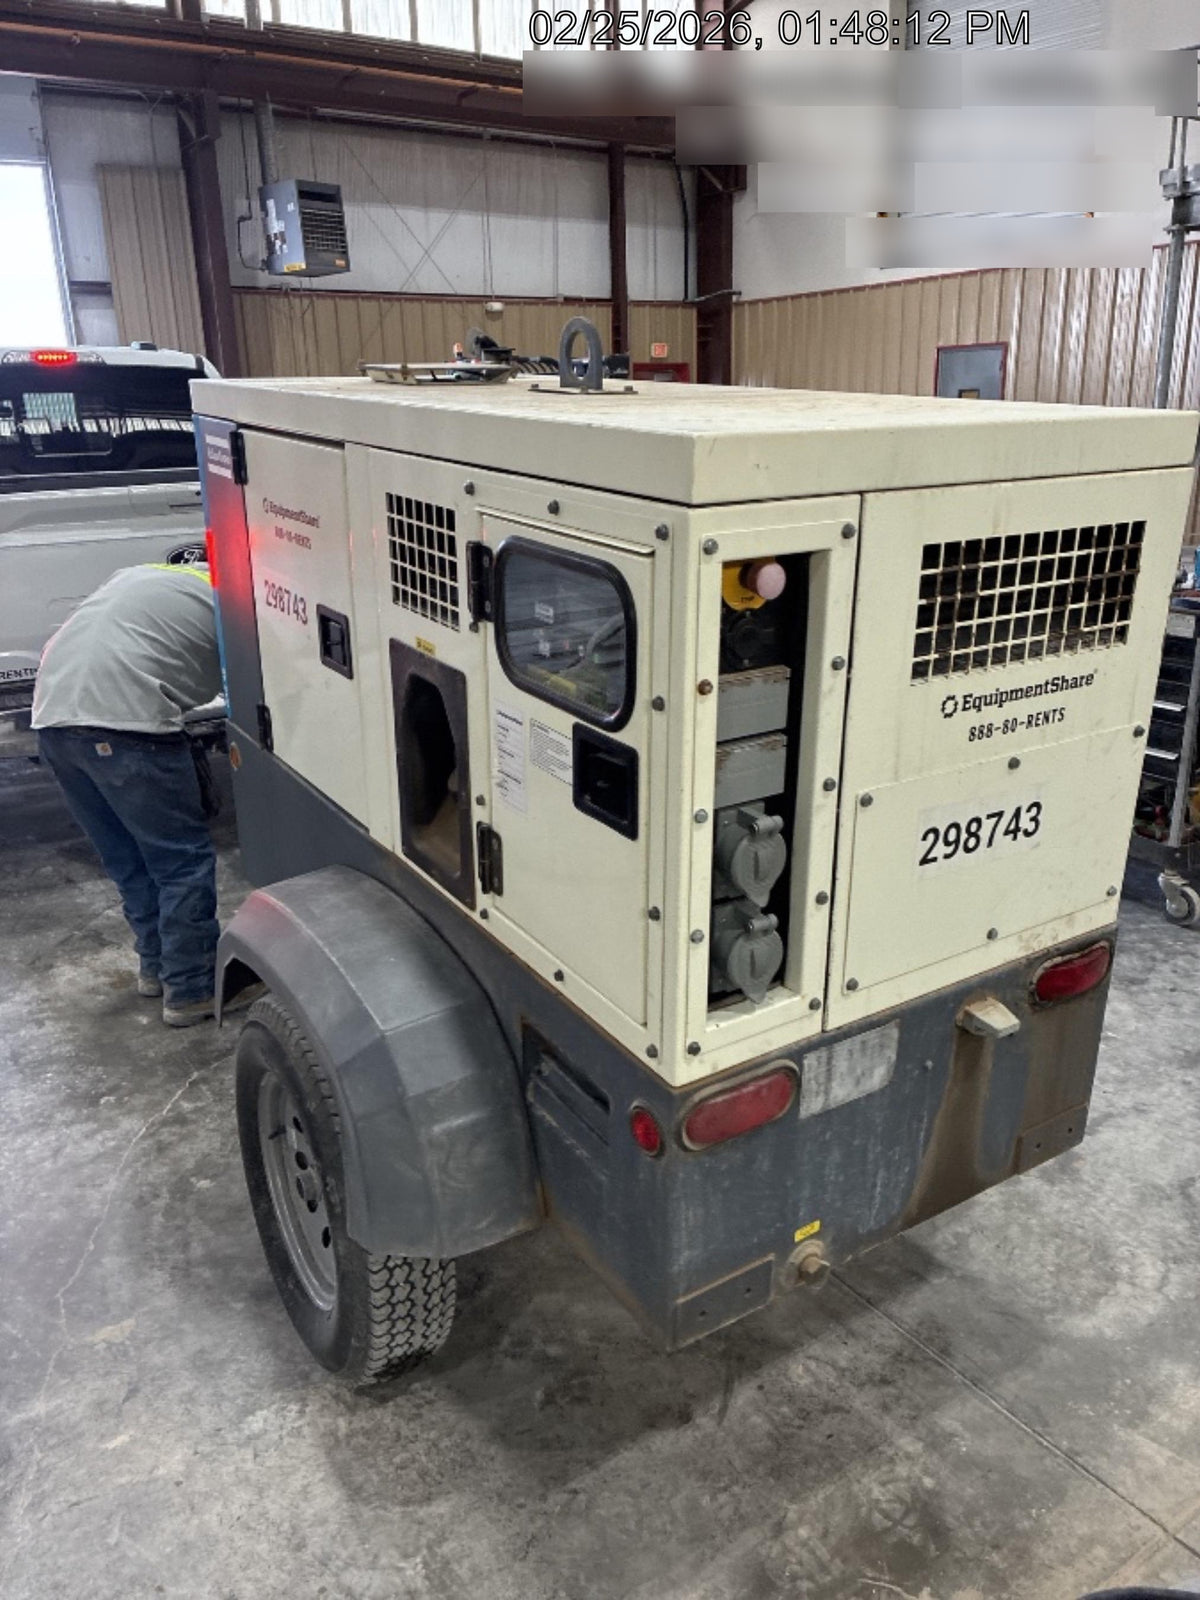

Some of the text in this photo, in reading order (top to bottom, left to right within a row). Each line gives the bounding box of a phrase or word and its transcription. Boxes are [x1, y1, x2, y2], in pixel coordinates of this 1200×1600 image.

[264, 579, 308, 625] 298743
[961, 673, 1095, 713] EquipmentShare
[968, 707, 1066, 742] 888-80-RENTS
[919, 801, 1042, 866] 298743
